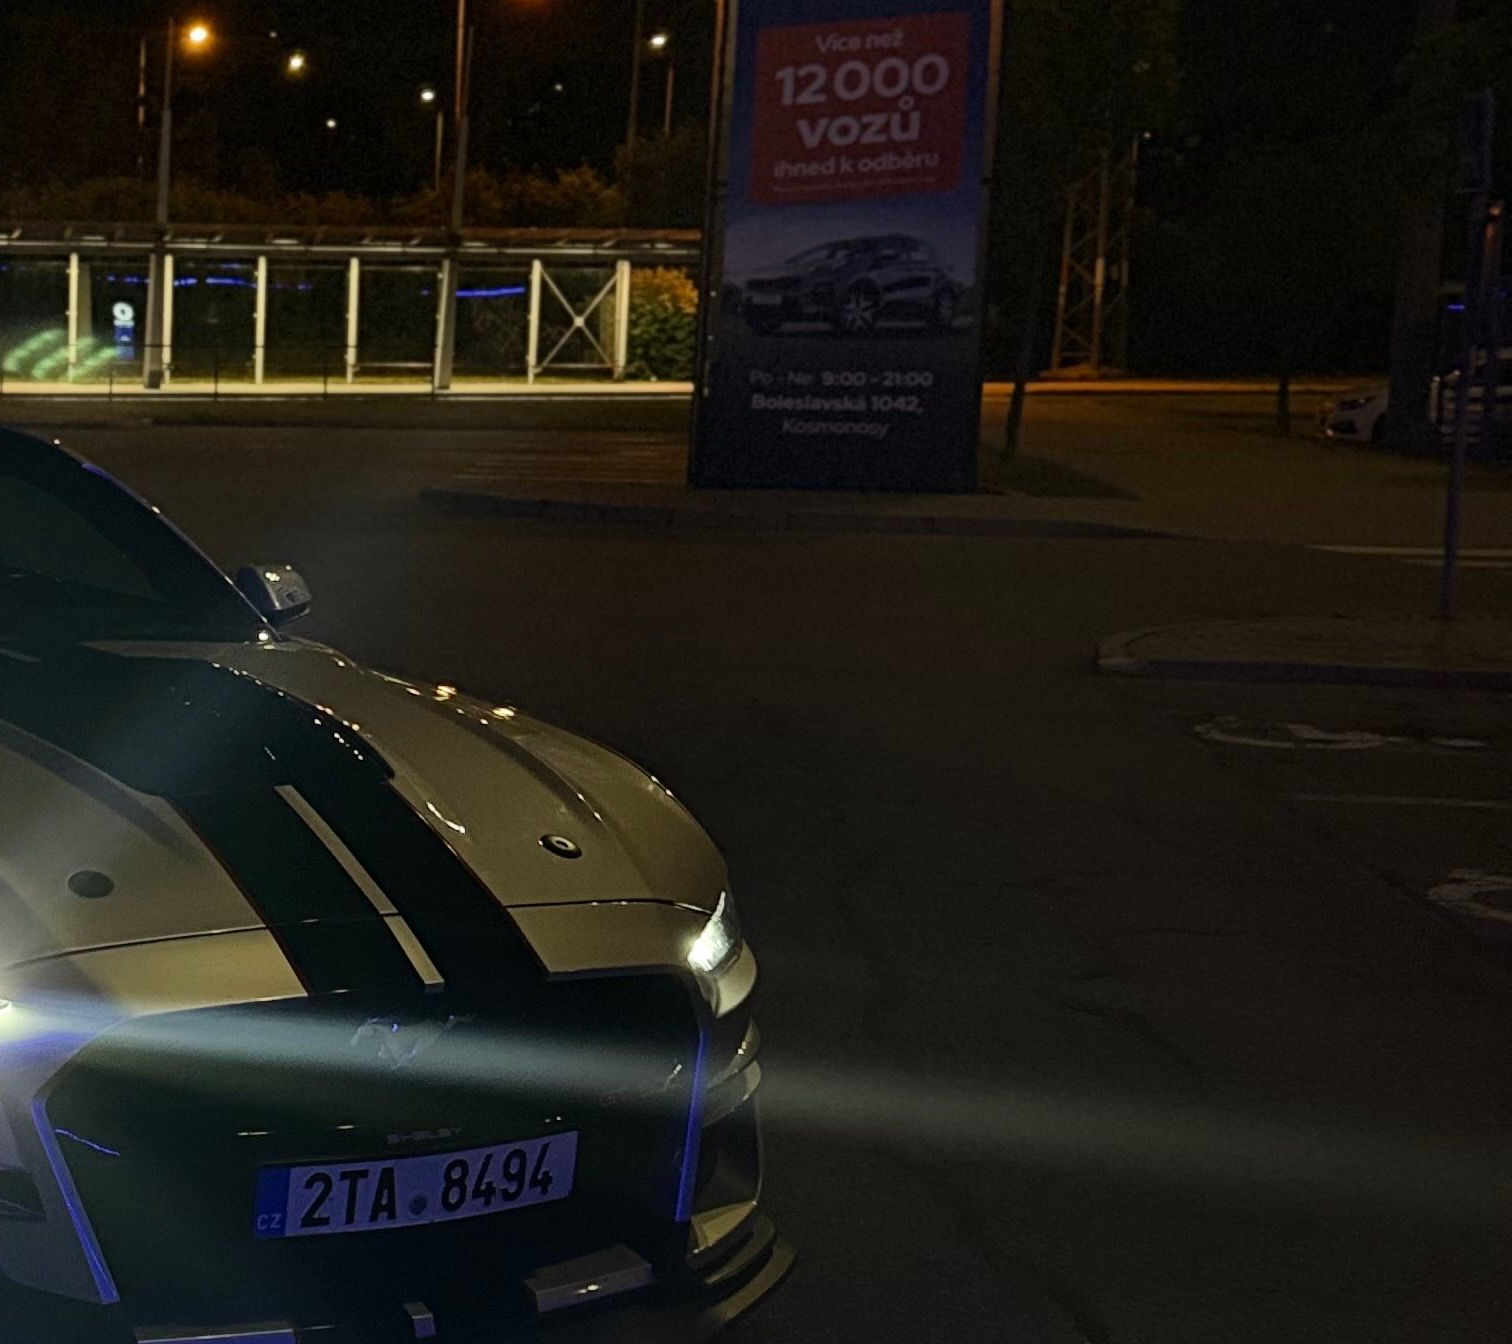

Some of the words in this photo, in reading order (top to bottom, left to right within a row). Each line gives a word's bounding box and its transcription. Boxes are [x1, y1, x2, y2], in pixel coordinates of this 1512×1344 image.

[815, 32, 861, 54] Více
[865, 28, 904, 50] než
[796, 95, 921, 149] vozů
[773, 157, 835, 178] ihned
[858, 150, 939, 173] odběru
[882, 370, 934, 388] 21:00
[300, 1167, 397, 1228] 2TA
[441, 1143, 553, 1212] 8494
[255, 1213, 282, 1231] CZ
